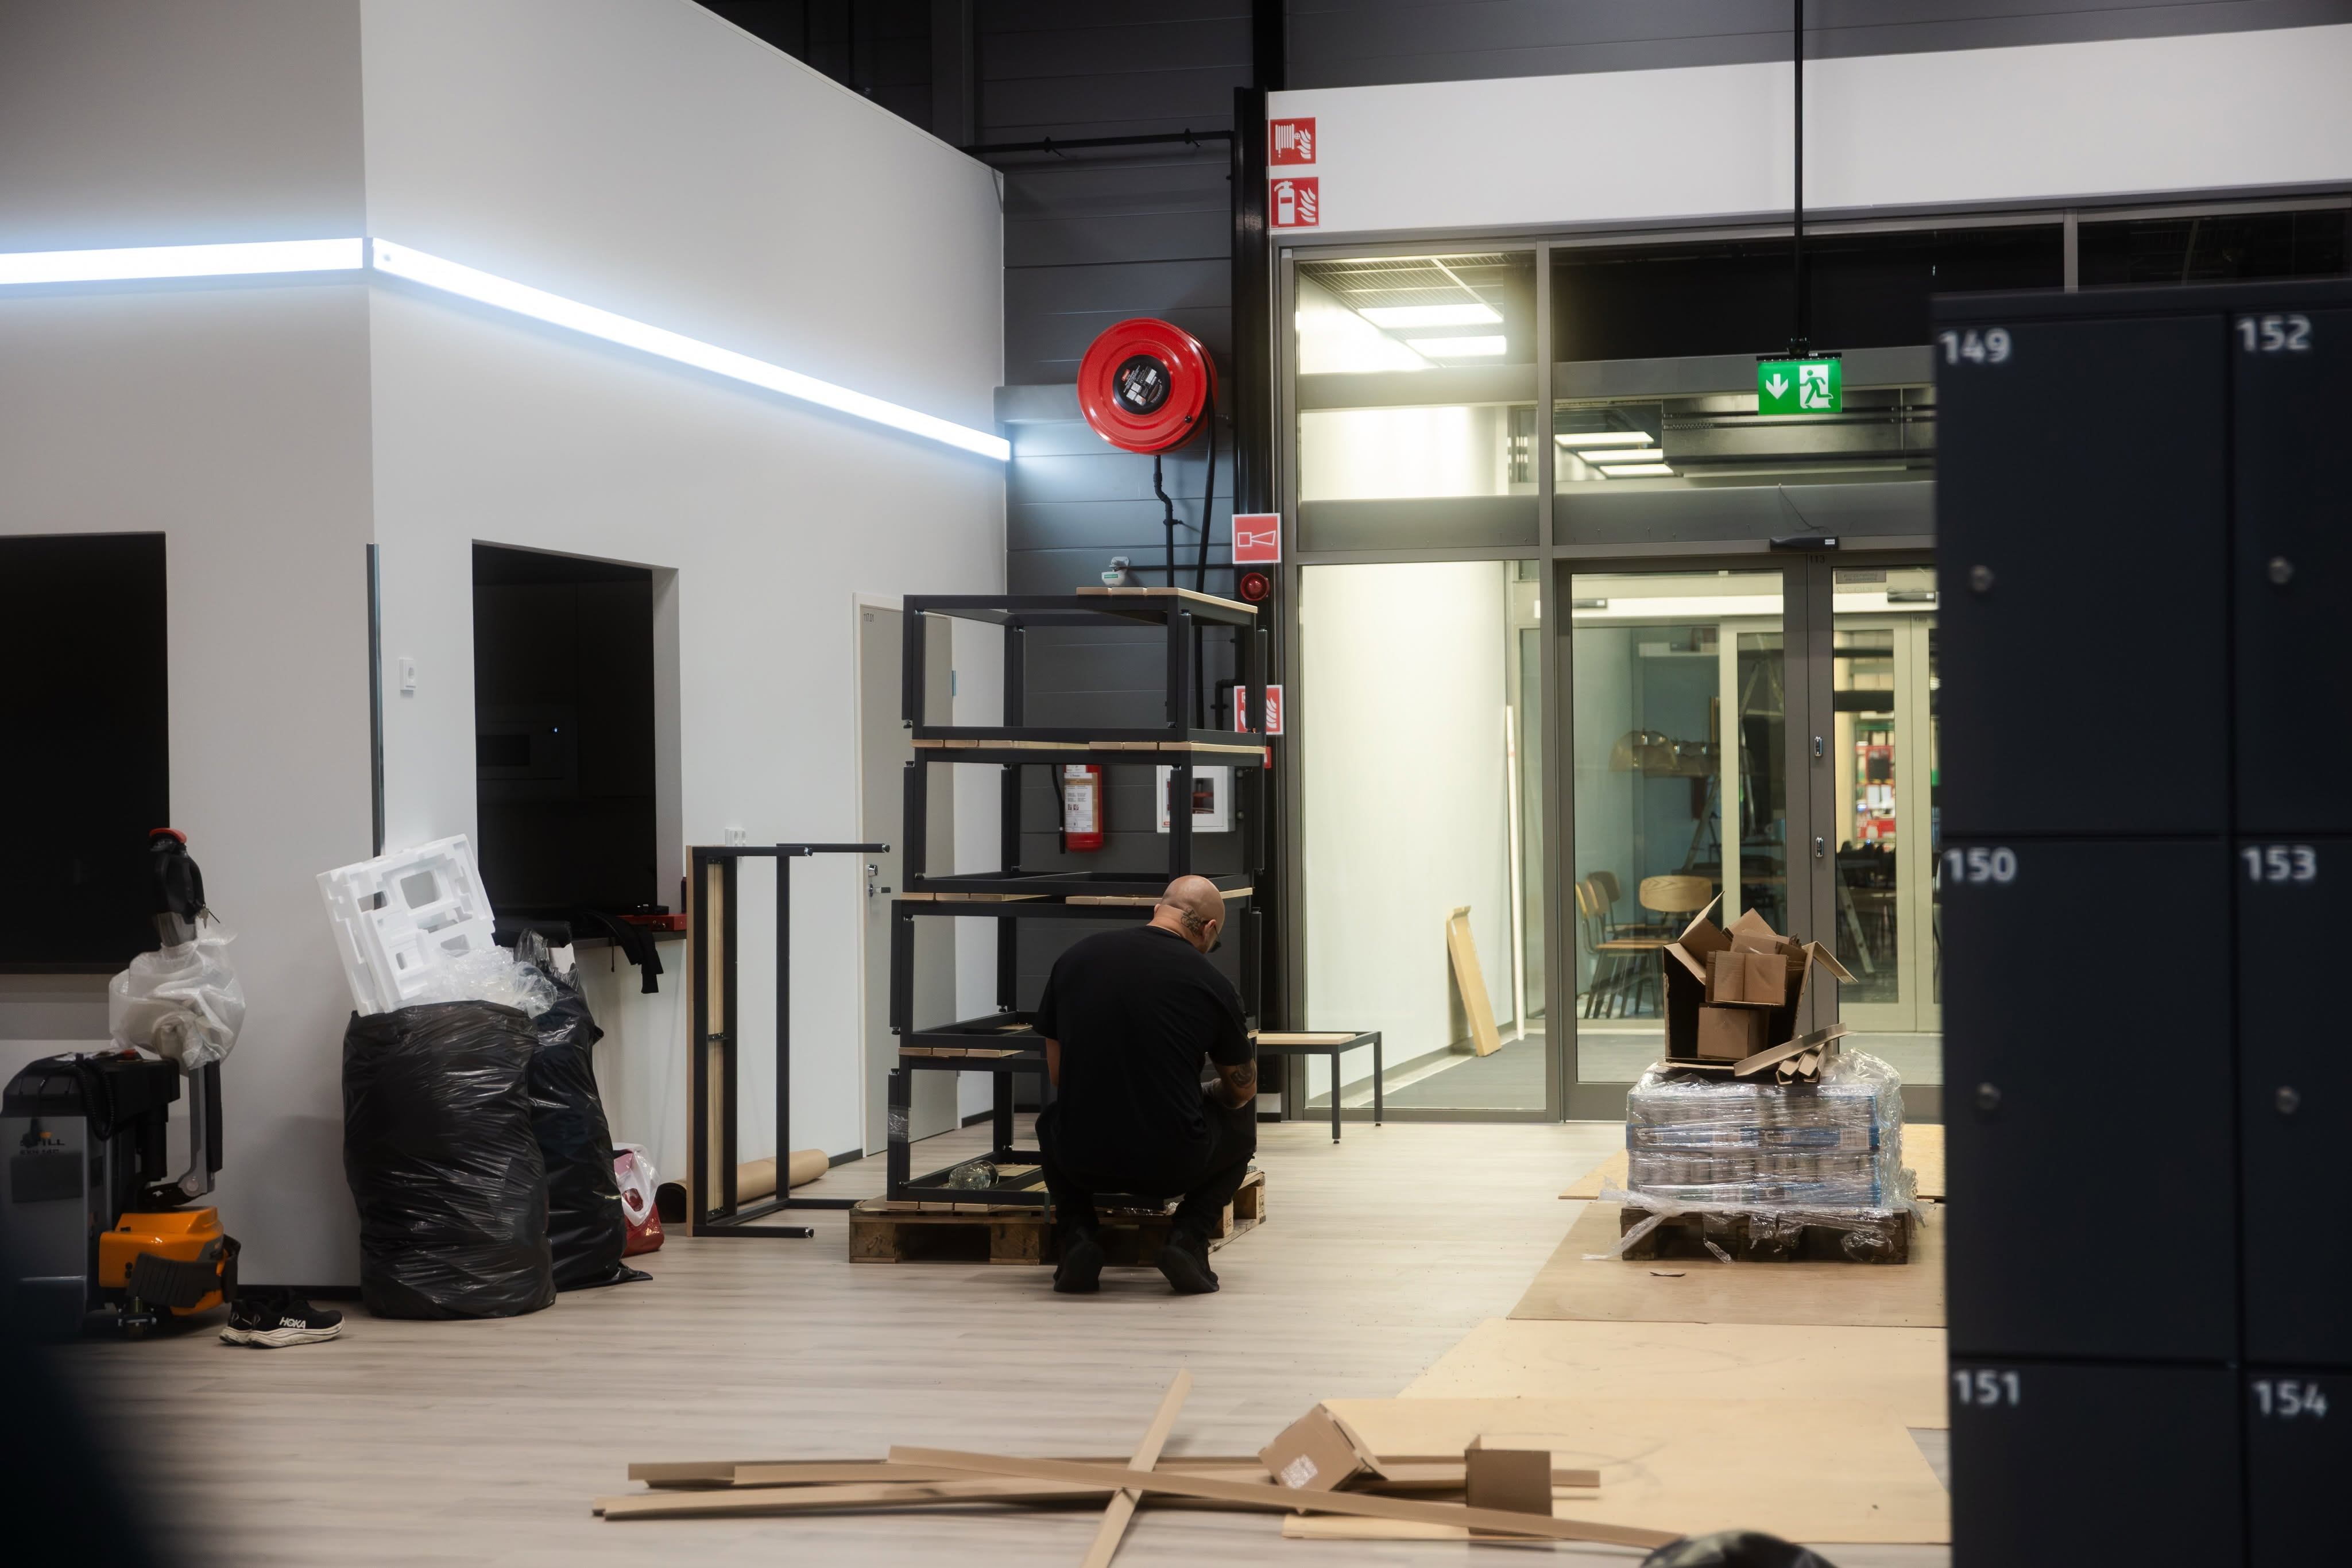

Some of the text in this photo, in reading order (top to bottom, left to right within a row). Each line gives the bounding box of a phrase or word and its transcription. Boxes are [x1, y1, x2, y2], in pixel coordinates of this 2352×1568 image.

[1939, 327, 2011, 365] 149
[2236, 315, 2311, 351] 152
[1943, 847, 2017, 883] 150
[2241, 845, 2316, 882] 153
[279, 1317, 306, 1329] HOKA
[1953, 1369, 2021, 1406] 151
[2252, 1380, 2327, 1417] 154
